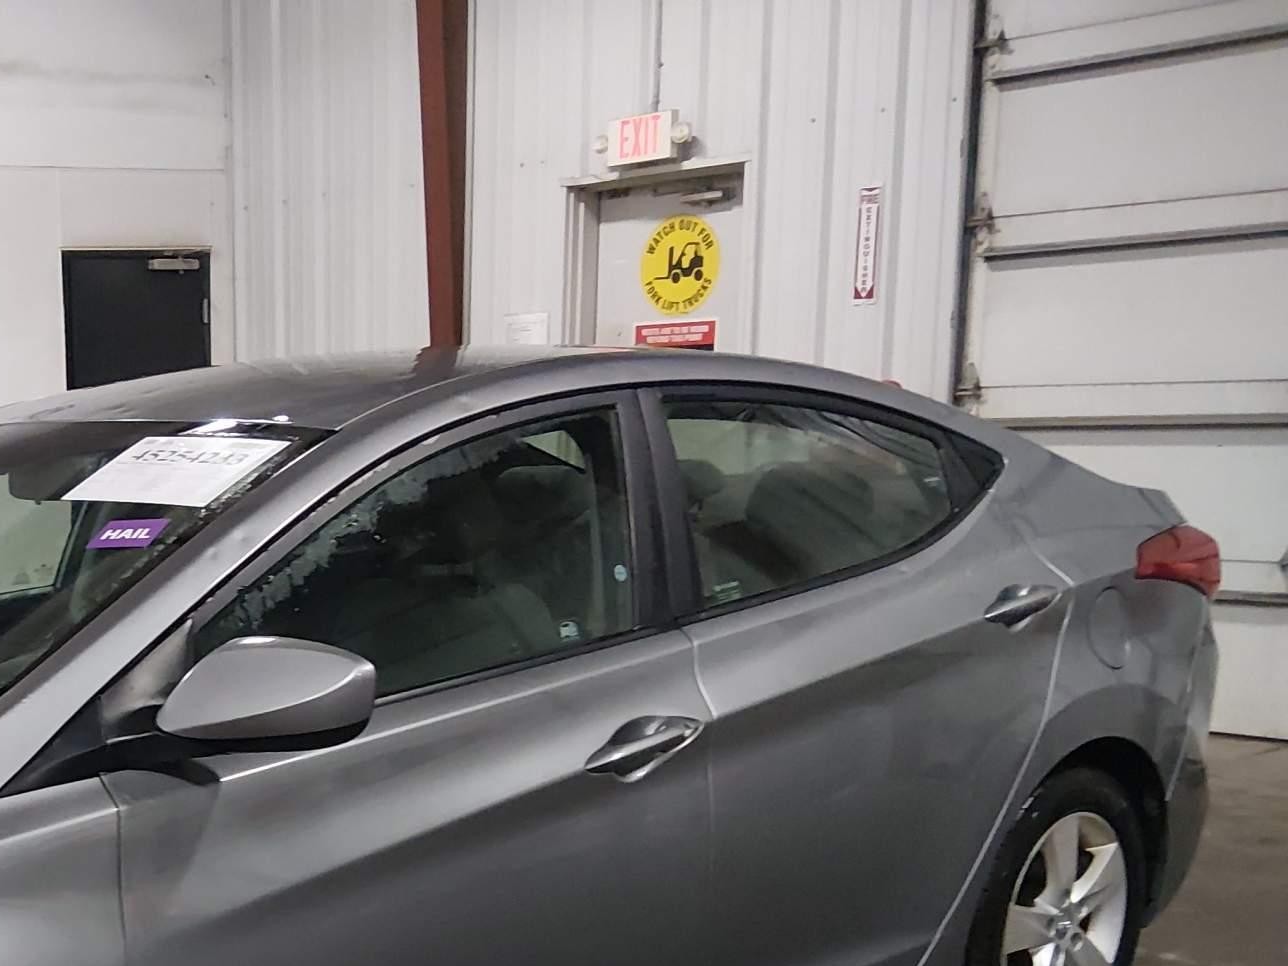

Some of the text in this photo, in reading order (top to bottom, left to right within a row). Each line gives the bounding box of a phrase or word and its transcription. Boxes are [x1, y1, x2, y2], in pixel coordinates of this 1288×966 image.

[619, 114, 661, 160] EXIT
[646, 218, 715, 255] WATCH OUT FOR
[644, 277, 712, 312] FORK LIFT TRUCKS
[100, 528, 151, 540] HAIL
